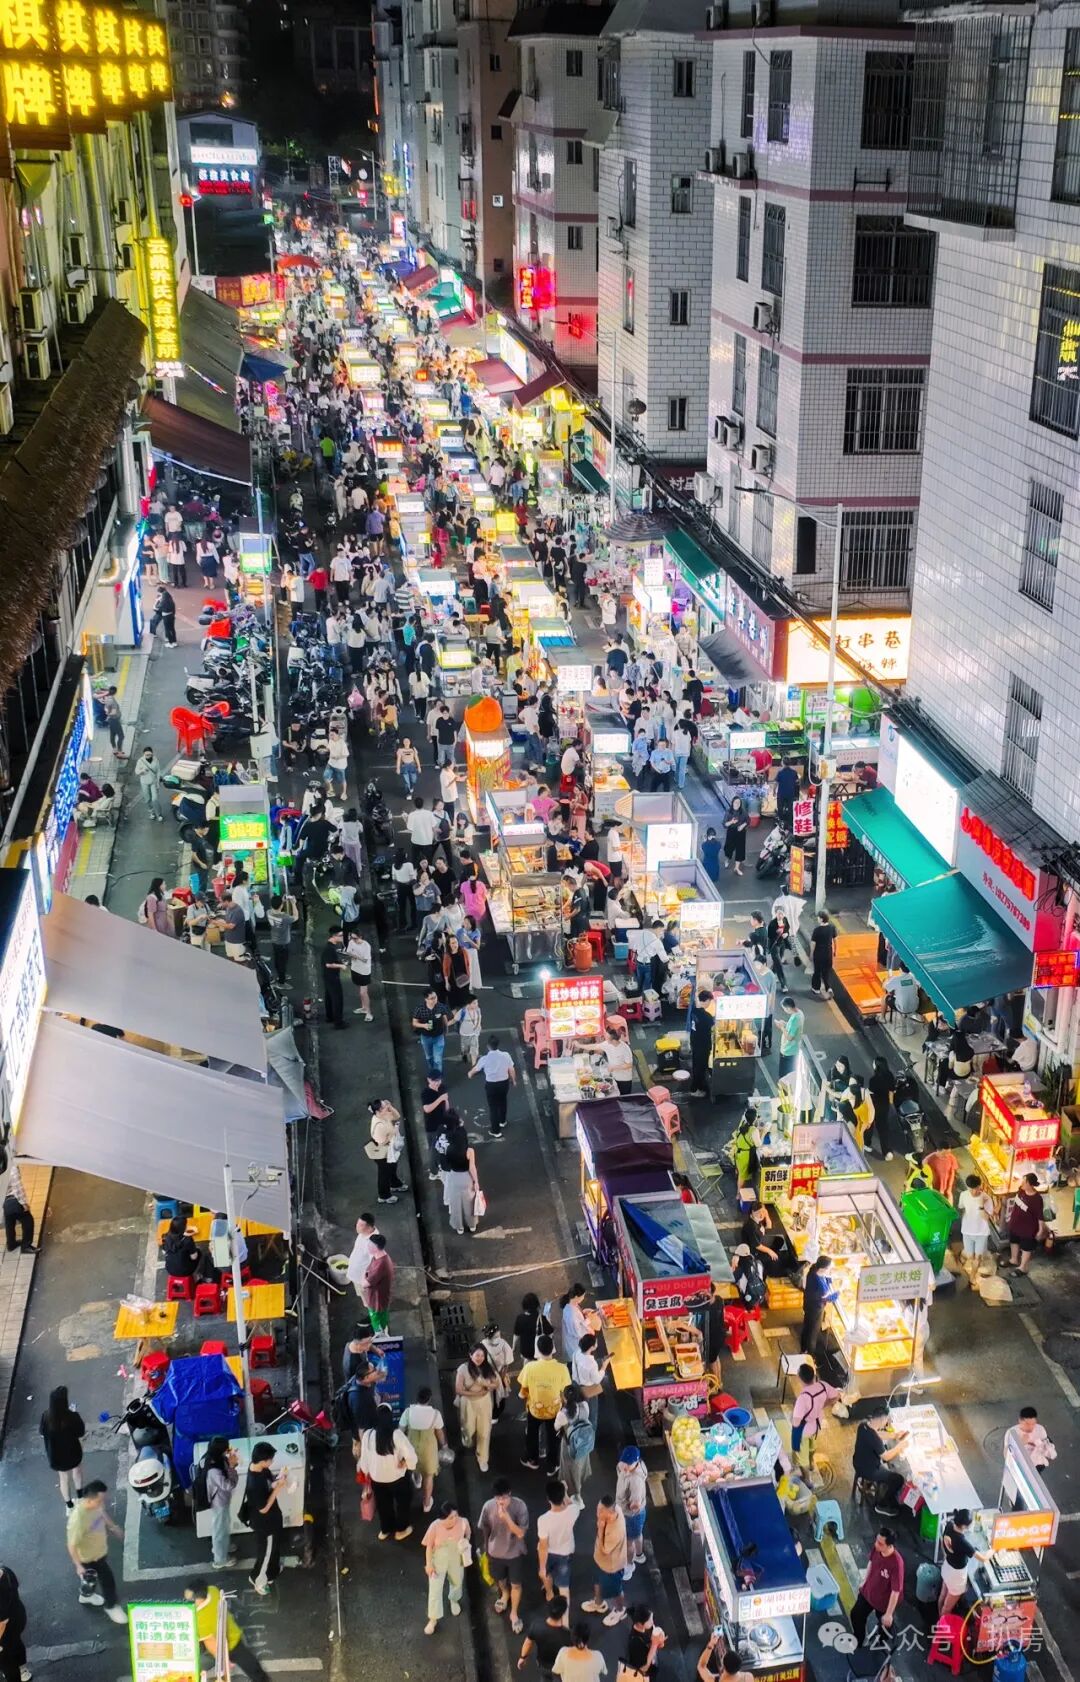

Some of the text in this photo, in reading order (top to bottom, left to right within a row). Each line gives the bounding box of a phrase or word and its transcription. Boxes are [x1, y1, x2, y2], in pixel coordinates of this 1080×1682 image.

[794, 801, 812, 833] 修鞋
[765, 1170, 788, 1181] 新鲜
[645, 1296, 682, 1311] 臭豆腐
[136, 1632, 189, 1641] 非遗美食
